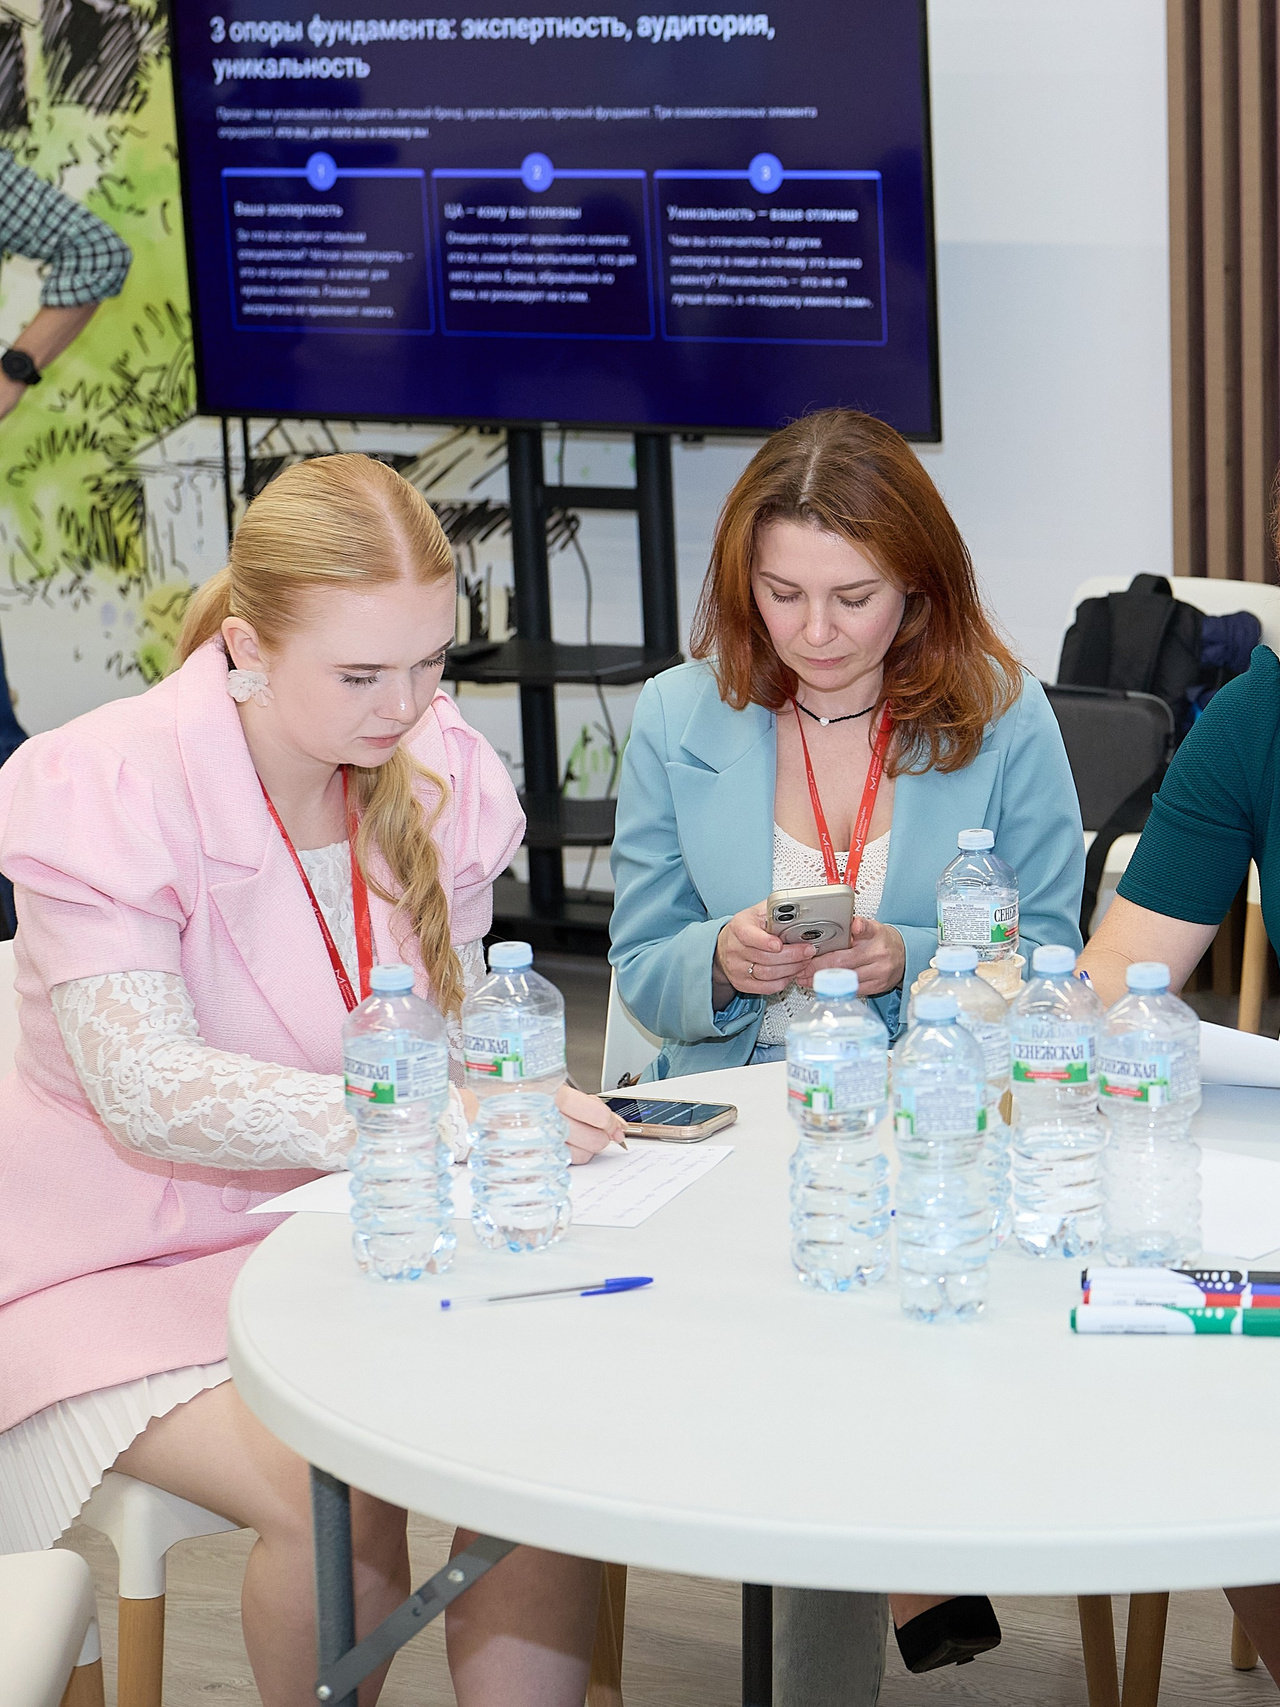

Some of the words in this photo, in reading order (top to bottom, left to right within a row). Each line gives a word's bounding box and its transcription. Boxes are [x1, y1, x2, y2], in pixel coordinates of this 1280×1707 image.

[209, 15, 226, 43] 3
[229, 21, 303, 48] опоры
[307, 13, 457, 48] фундамента:
[460, 16, 633, 45] экспертность,
[636, 14, 776, 43] аудитория,
[211, 57, 371, 85] уникальность
[444, 203, 464, 220] ЦА
[476, 207, 509, 222] кому
[508, 207, 527, 219] вы
[528, 207, 582, 219] полезны
[667, 205, 755, 222] Уникальность
[769, 208, 804, 222] ваше
[805, 208, 858, 222] отличие
